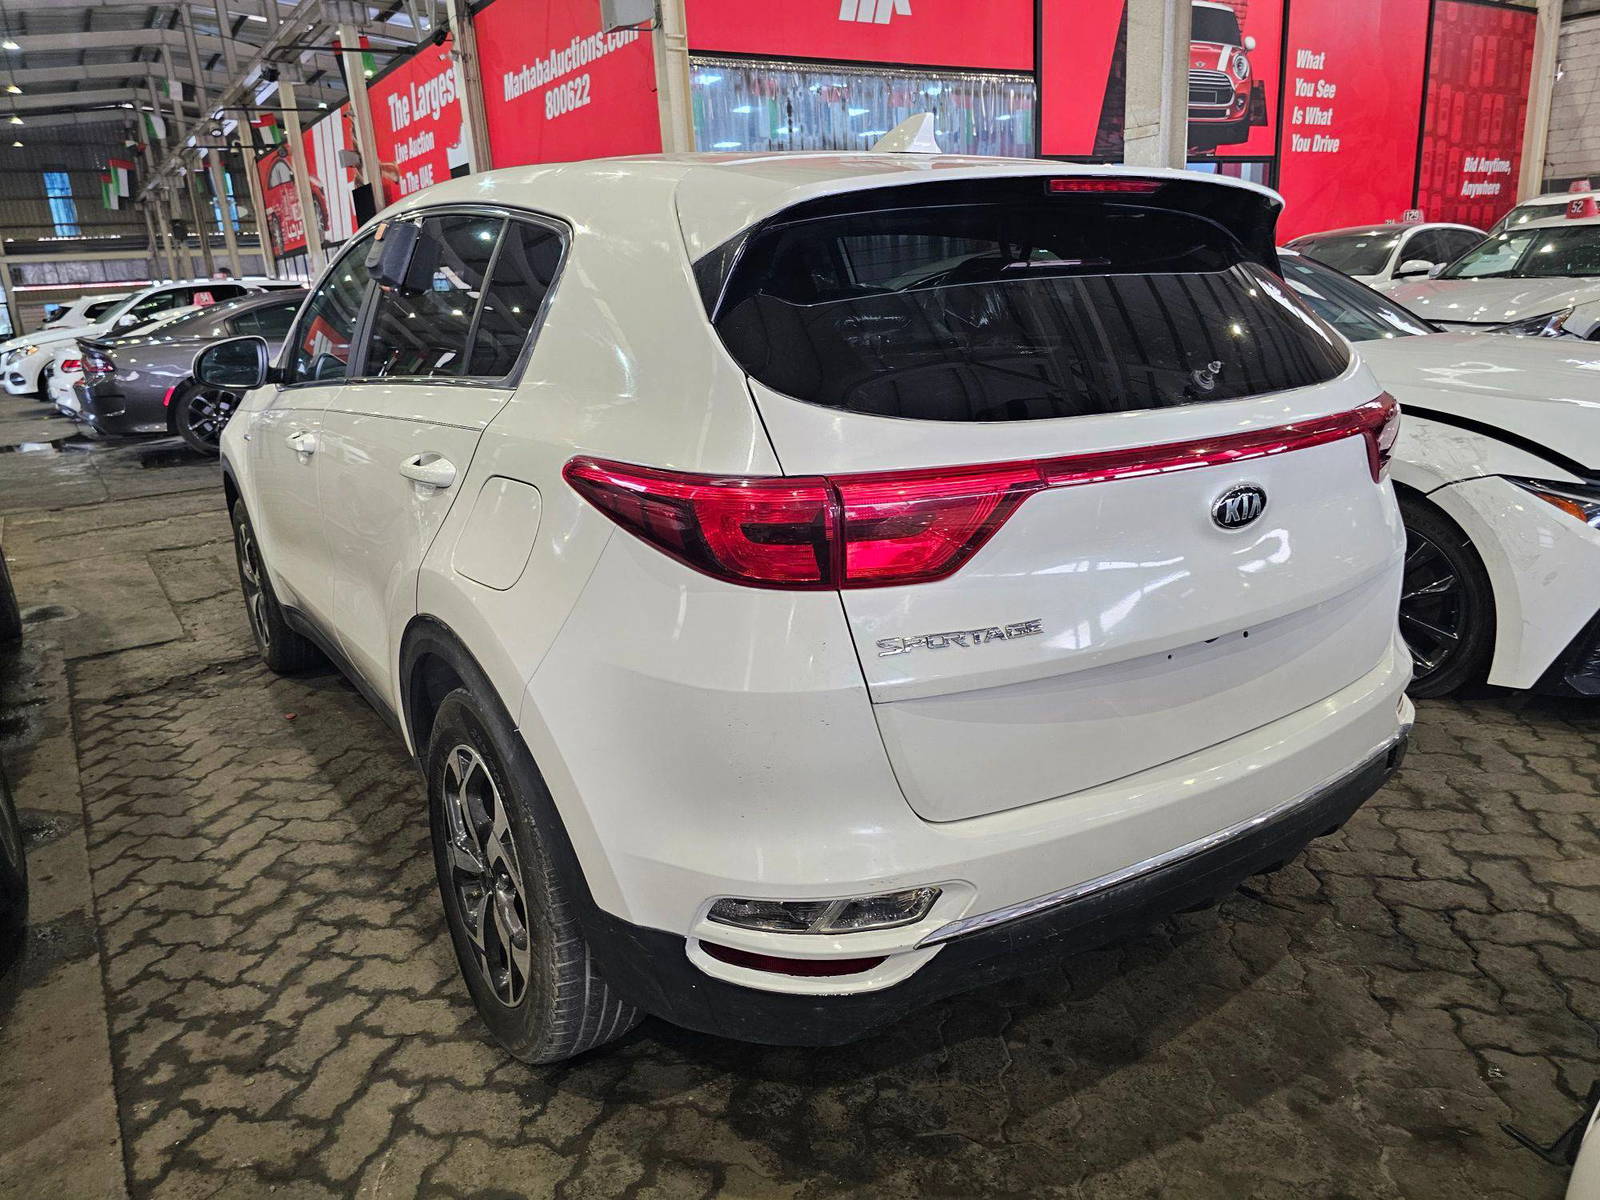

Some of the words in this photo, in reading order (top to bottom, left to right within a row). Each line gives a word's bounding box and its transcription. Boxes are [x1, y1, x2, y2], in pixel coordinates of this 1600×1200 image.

[1296, 49, 1325, 70] What
[545, 73, 591, 120] 800622
[1295, 77, 1315, 97] You
[1316, 79, 1336, 98] See
[388, 92, 410, 132] The
[1291, 106, 1303, 124] Is
[1305, 106, 1333, 125] What
[394, 143, 408, 165] Live
[408, 131, 435, 160] Auction
[1291, 134, 1311, 152] You
[1312, 134, 1340, 152] Drive
[1464, 157, 1479, 172] Bid
[406, 171, 420, 193] The
[1461, 180, 1501, 199] Anywhere
[1224, 493, 1262, 524] KIA
[876, 618, 1044, 657] SPORTAGE
